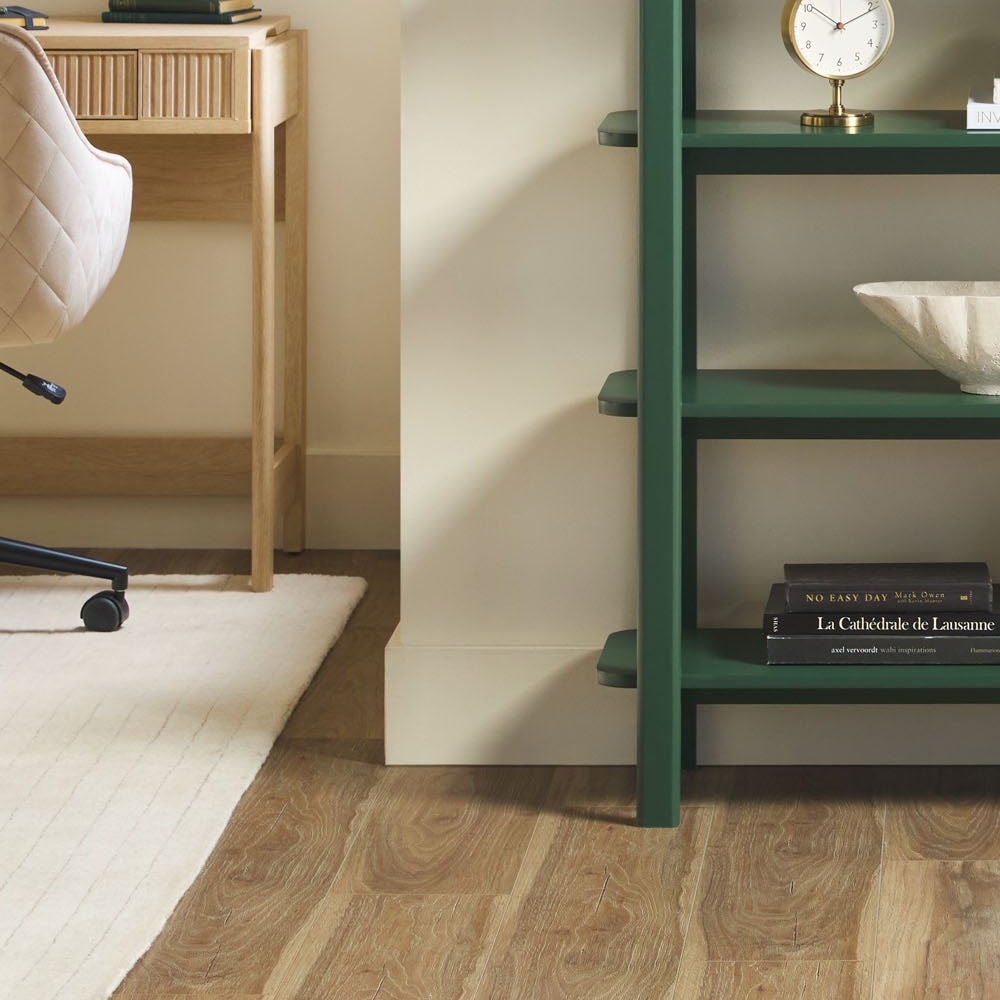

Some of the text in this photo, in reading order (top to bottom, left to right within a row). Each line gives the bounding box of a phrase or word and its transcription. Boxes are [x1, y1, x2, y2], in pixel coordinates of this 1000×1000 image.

[804, 3, 813, 13] 10
[801, 22, 807, 31] 9
[872, 20, 878, 29] 3
[806, 40, 811, 49] 8
[867, 38, 873, 47] 4
[818, 53, 824, 62] 7
[855, 52, 860, 61] 5
[837, 57, 843, 66] 6
[805, 593, 824, 602] NO
[829, 593, 859, 602] EASY
[864, 593, 888, 602] DAY
[894, 591, 917, 599] Mark
[921, 591, 945, 599] Owen
[817, 616, 995, 631] La Cathédrale de Lausanne
